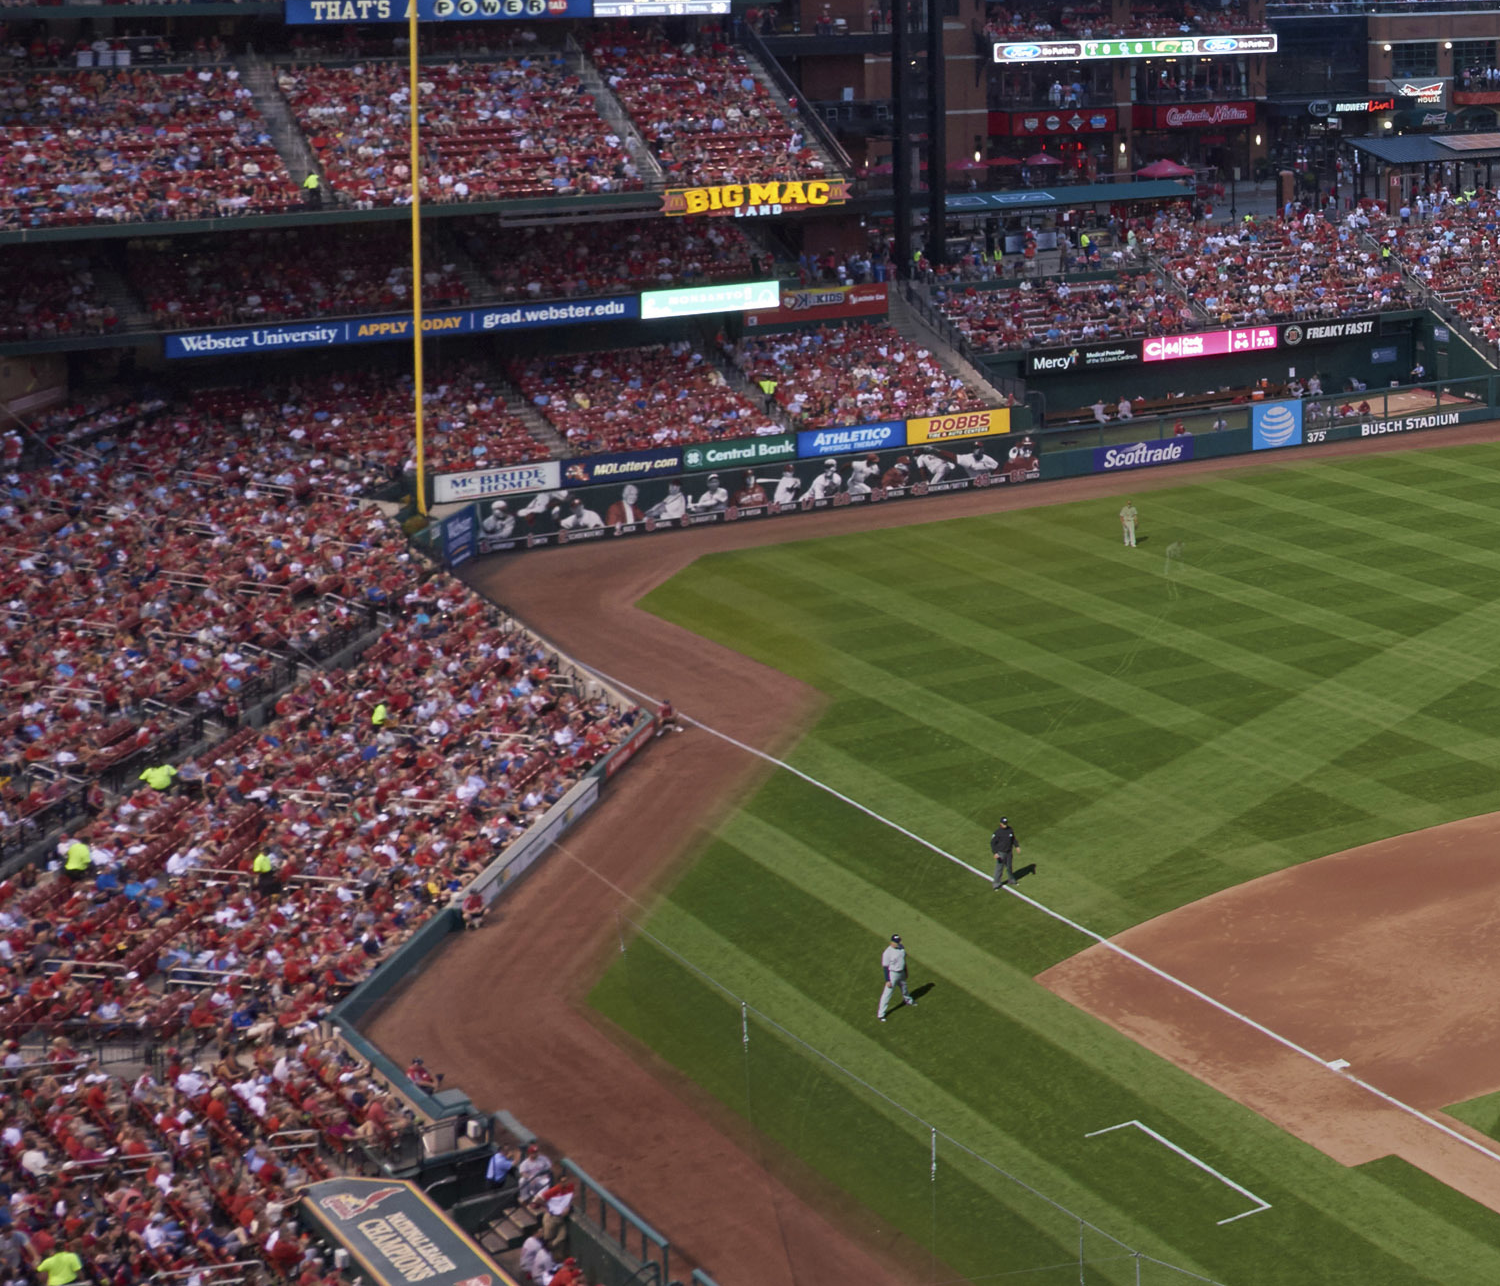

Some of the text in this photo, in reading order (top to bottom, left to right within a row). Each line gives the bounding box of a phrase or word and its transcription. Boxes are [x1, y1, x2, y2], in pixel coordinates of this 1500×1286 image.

[310, 0, 391, 20] THAT'S
[1336, 102, 1368, 112] MIDWEST
[684, 181, 831, 214] BIG MAC
[734, 204, 783, 217] LAND
[483, 301, 625, 329] grad.webster.edu
[180, 333, 249, 353] Webster
[252, 326, 337, 347] University
[357, 321, 407, 337] APPLY
[1306, 321, 1373, 339] FREAKY FAST!
[1033, 355, 1071, 371] Mercy
[929, 414, 990, 433] DOBBS
[1361, 413, 1459, 437] BUSCH STADIUM
[813, 427, 891, 447] ATHLETICO
[1307, 431, 1326, 443] 375'
[706, 439, 795, 462] Central Bank
[1104, 442, 1182, 469] Scottrade
[594, 456, 678, 477] MOLottery.com
[480, 476, 547, 494] HOMES
[357, 1218, 437, 1282] CHAMPIONS
